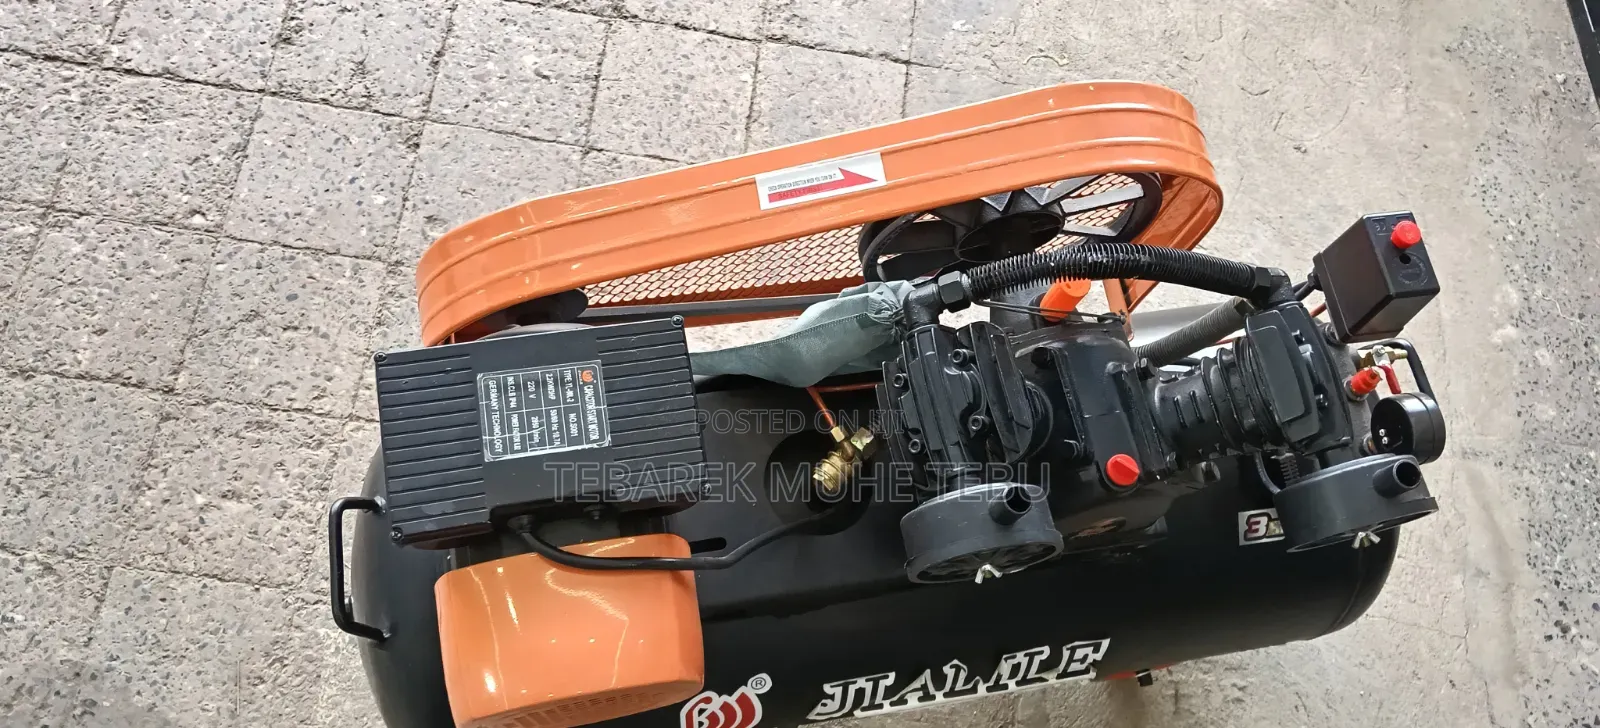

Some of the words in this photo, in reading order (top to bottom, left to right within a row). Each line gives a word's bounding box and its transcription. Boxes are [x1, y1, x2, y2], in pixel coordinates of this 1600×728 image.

[489, 380, 499, 410] GERMANY
[527, 381, 536, 392] 220
[587, 410, 598, 424] START
[491, 411, 504, 453] TECHNOLOGY
[588, 424, 600, 441] MOTOR
